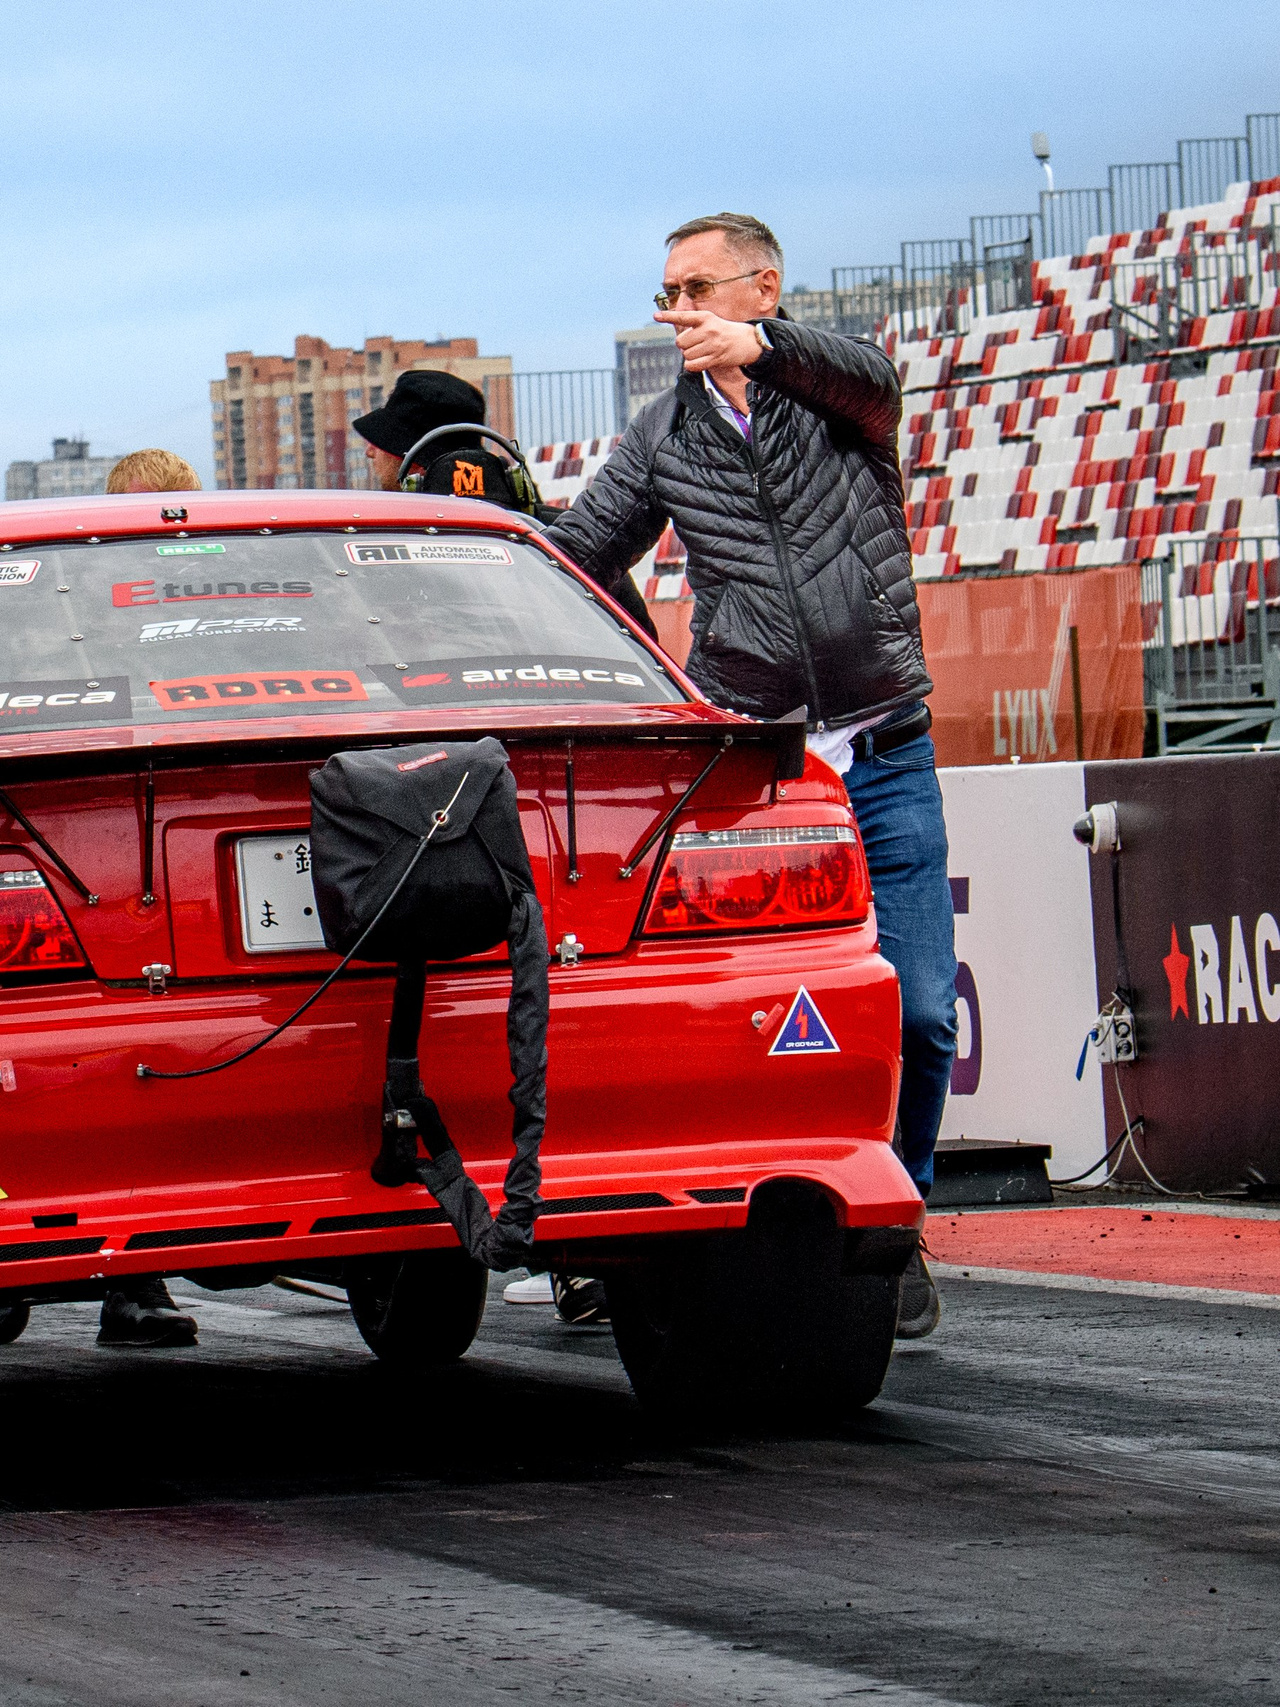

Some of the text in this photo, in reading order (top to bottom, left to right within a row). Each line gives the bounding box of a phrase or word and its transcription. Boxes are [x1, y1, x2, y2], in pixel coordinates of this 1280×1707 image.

[412, 552, 505, 561] TRANSMISSION
[420, 545, 492, 554] AUTOMATIC
[246, 626, 308, 634] SYSTEMS
[462, 664, 645, 687] ardeca
[162, 677, 353, 703] RDRC
[993, 688, 1058, 756] LYNX
